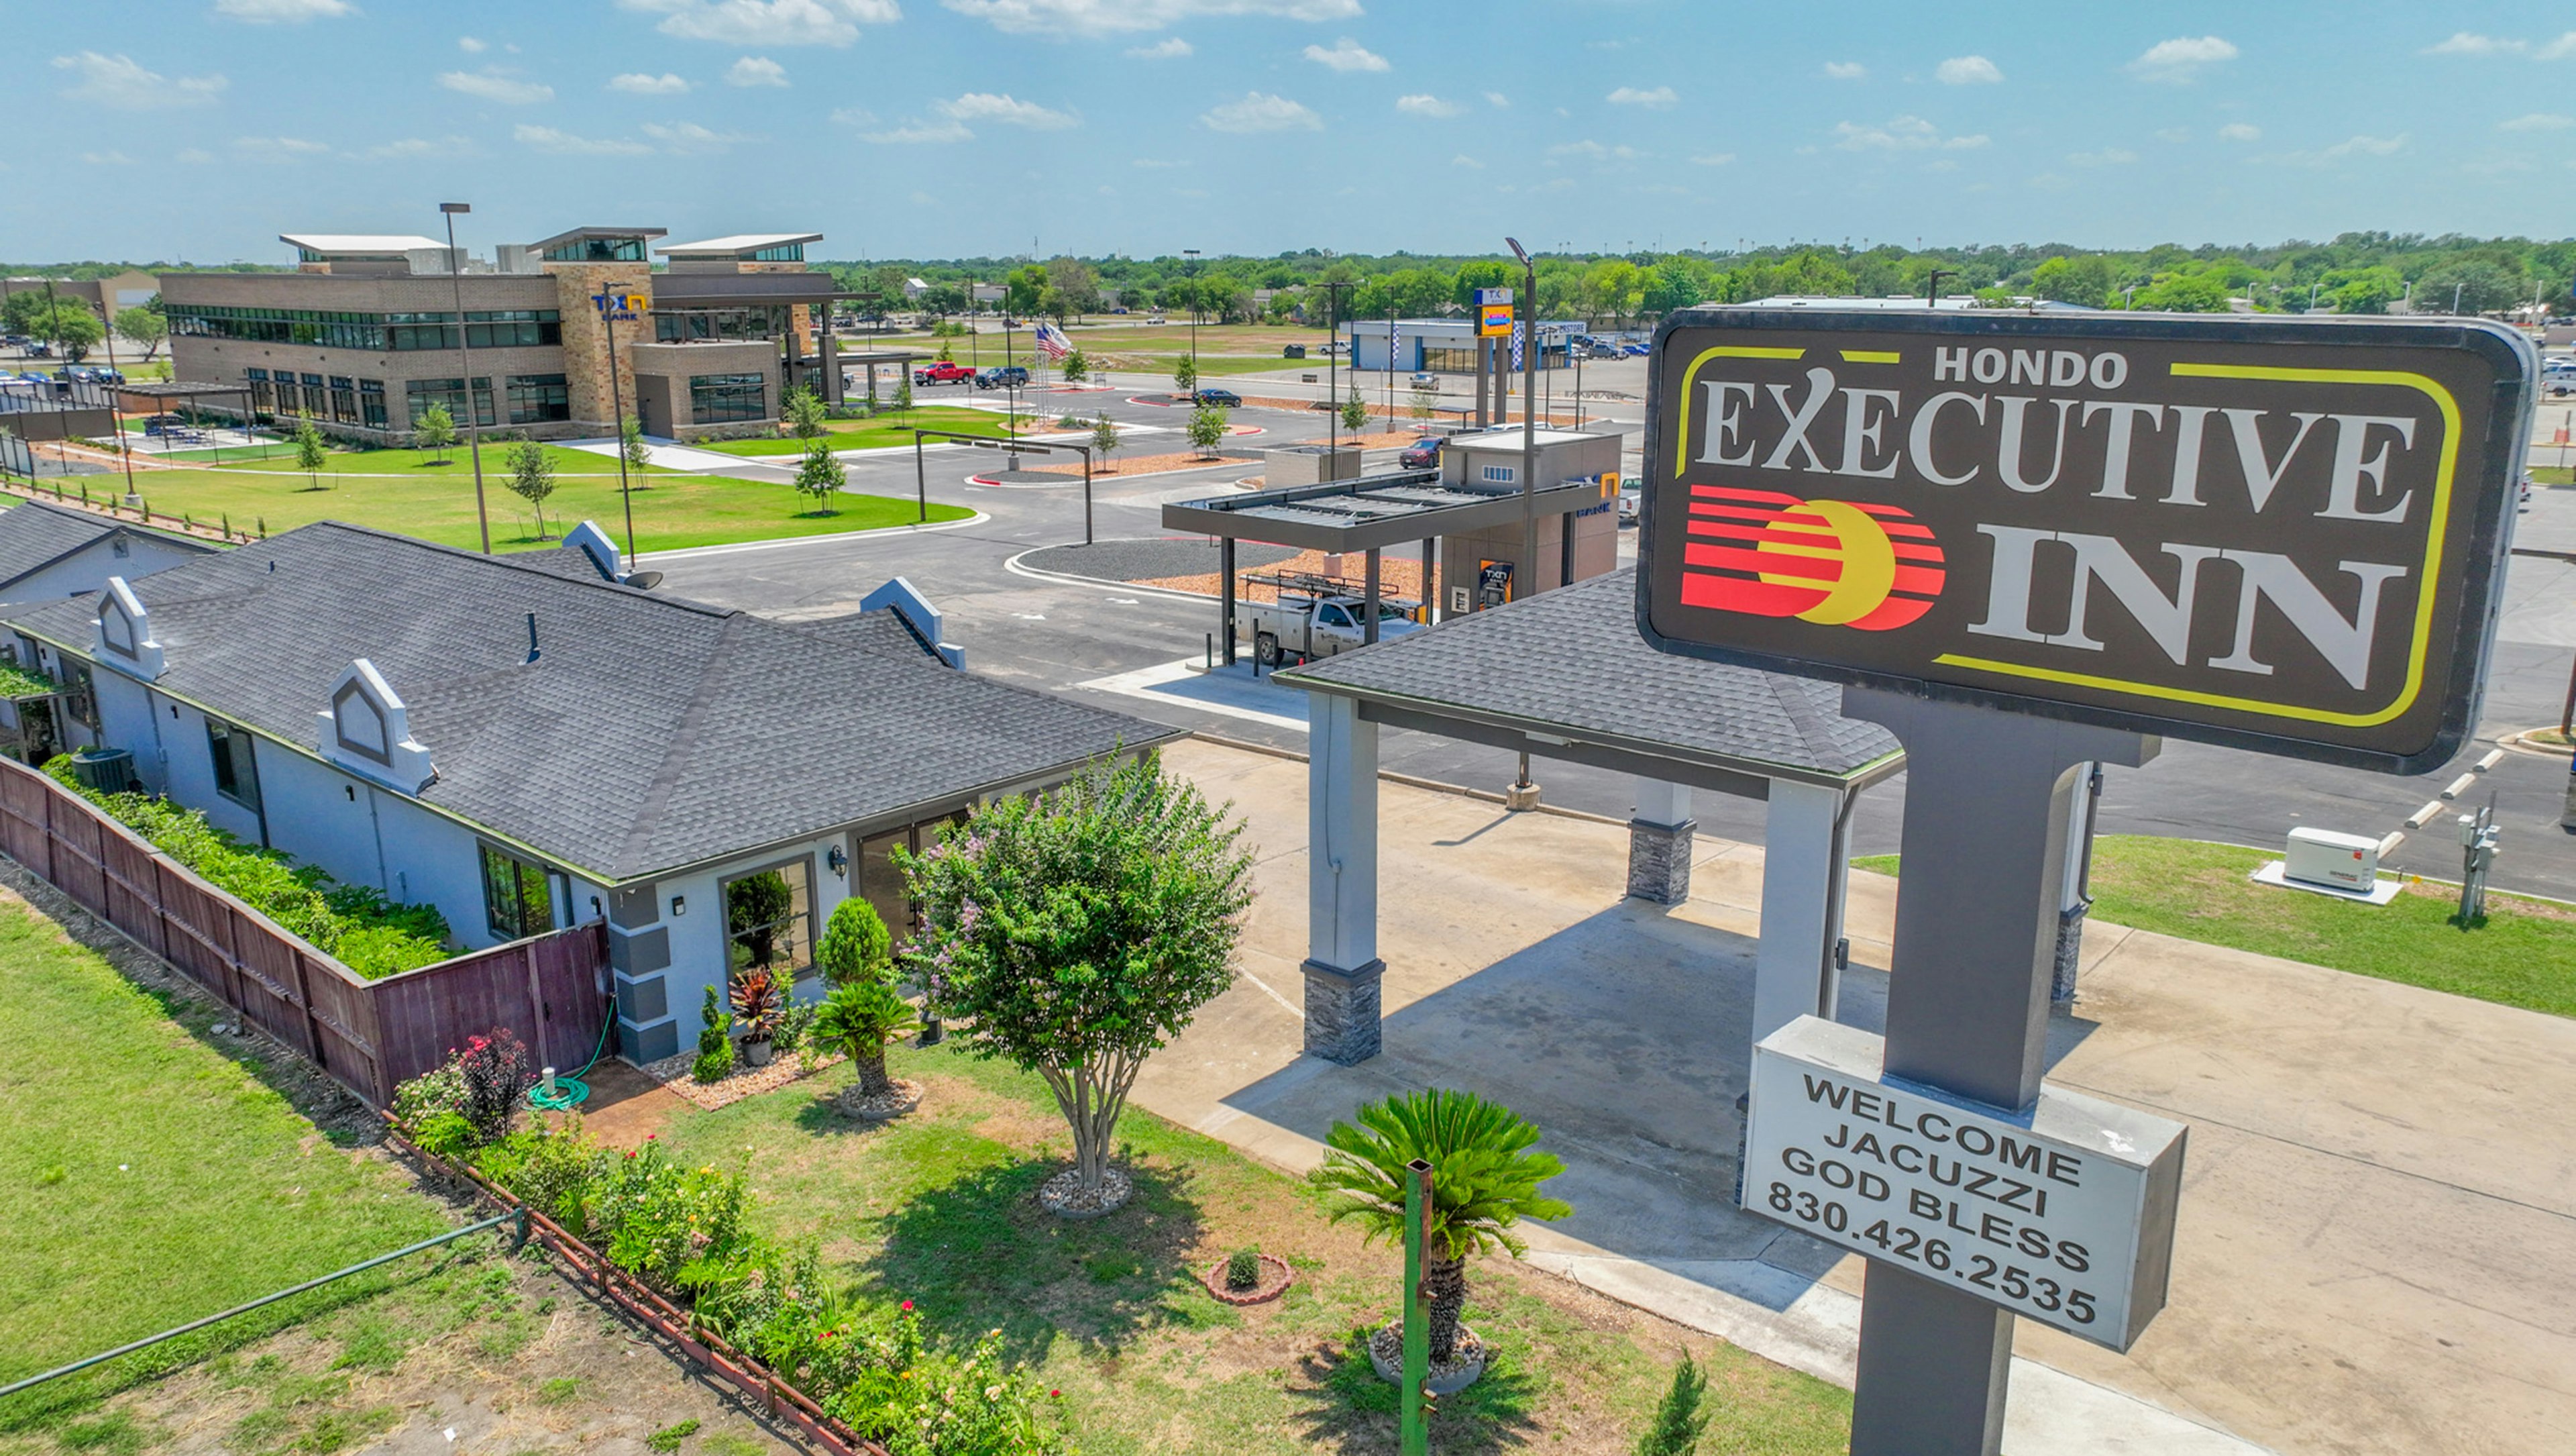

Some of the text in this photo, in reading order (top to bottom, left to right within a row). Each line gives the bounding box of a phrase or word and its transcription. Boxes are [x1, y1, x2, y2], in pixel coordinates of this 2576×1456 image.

[1934, 347, 2127, 389] HONDO
[1695, 367, 2416, 523] EXECUTIVE
[1967, 523, 2408, 690] INN
[1803, 1074, 2082, 1188] WELCOME
[1823, 1124, 2047, 1218] JACUZZI
[1768, 1182, 2096, 1324] 830.426.2535
[1782, 1147, 2090, 1273] GOD BLESS
